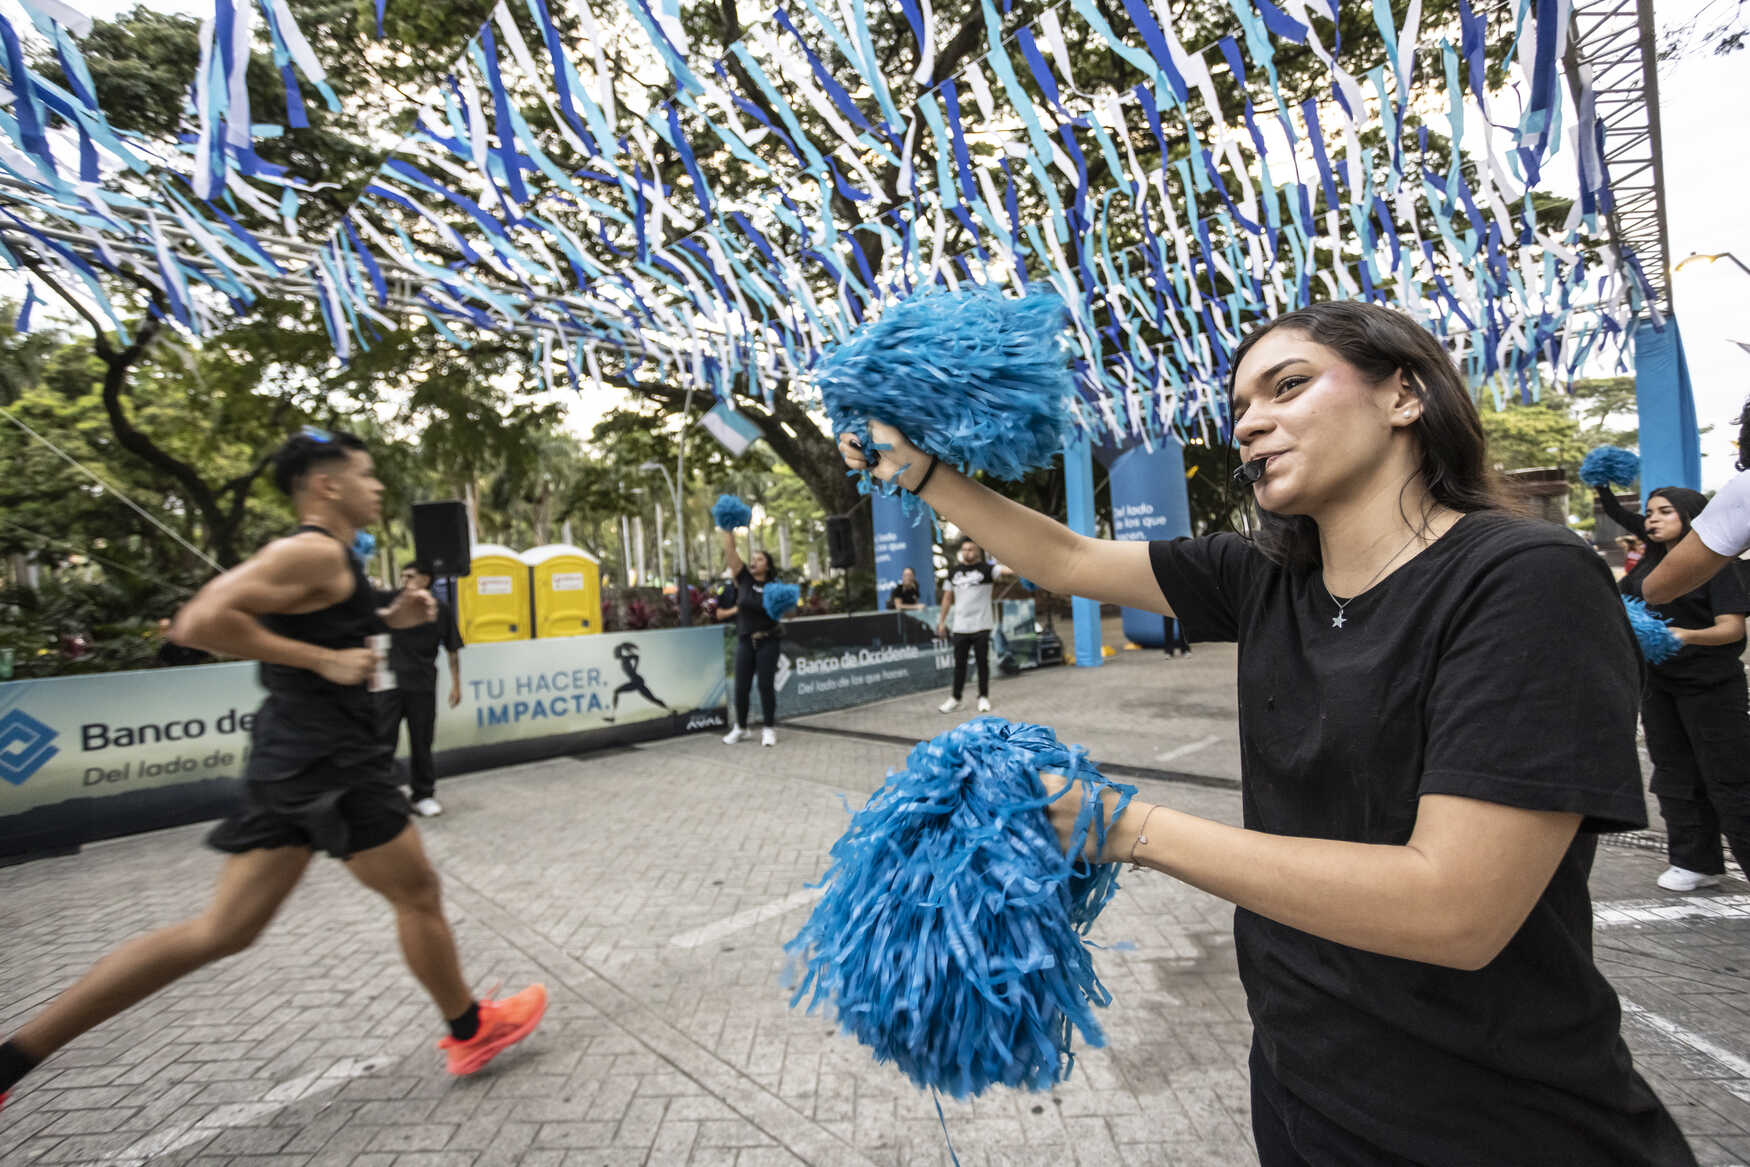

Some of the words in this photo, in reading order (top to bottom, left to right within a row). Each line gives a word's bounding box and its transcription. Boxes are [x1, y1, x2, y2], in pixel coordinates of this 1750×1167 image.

[1127, 502, 1154, 516] lado
[1142, 515, 1167, 529] que
[796, 657, 839, 676] Banco
[841, 651, 858, 669] de
[859, 645, 920, 666] Occidente
[469, 679, 505, 701] TU
[515, 667, 608, 697] HACER.
[476, 693, 610, 729] IMPACTA.
[81, 718, 206, 752] Banco
[216, 709, 258, 735] de
[83, 762, 131, 787] Del
[138, 755, 198, 779] lado
[203, 750, 235, 769] de
